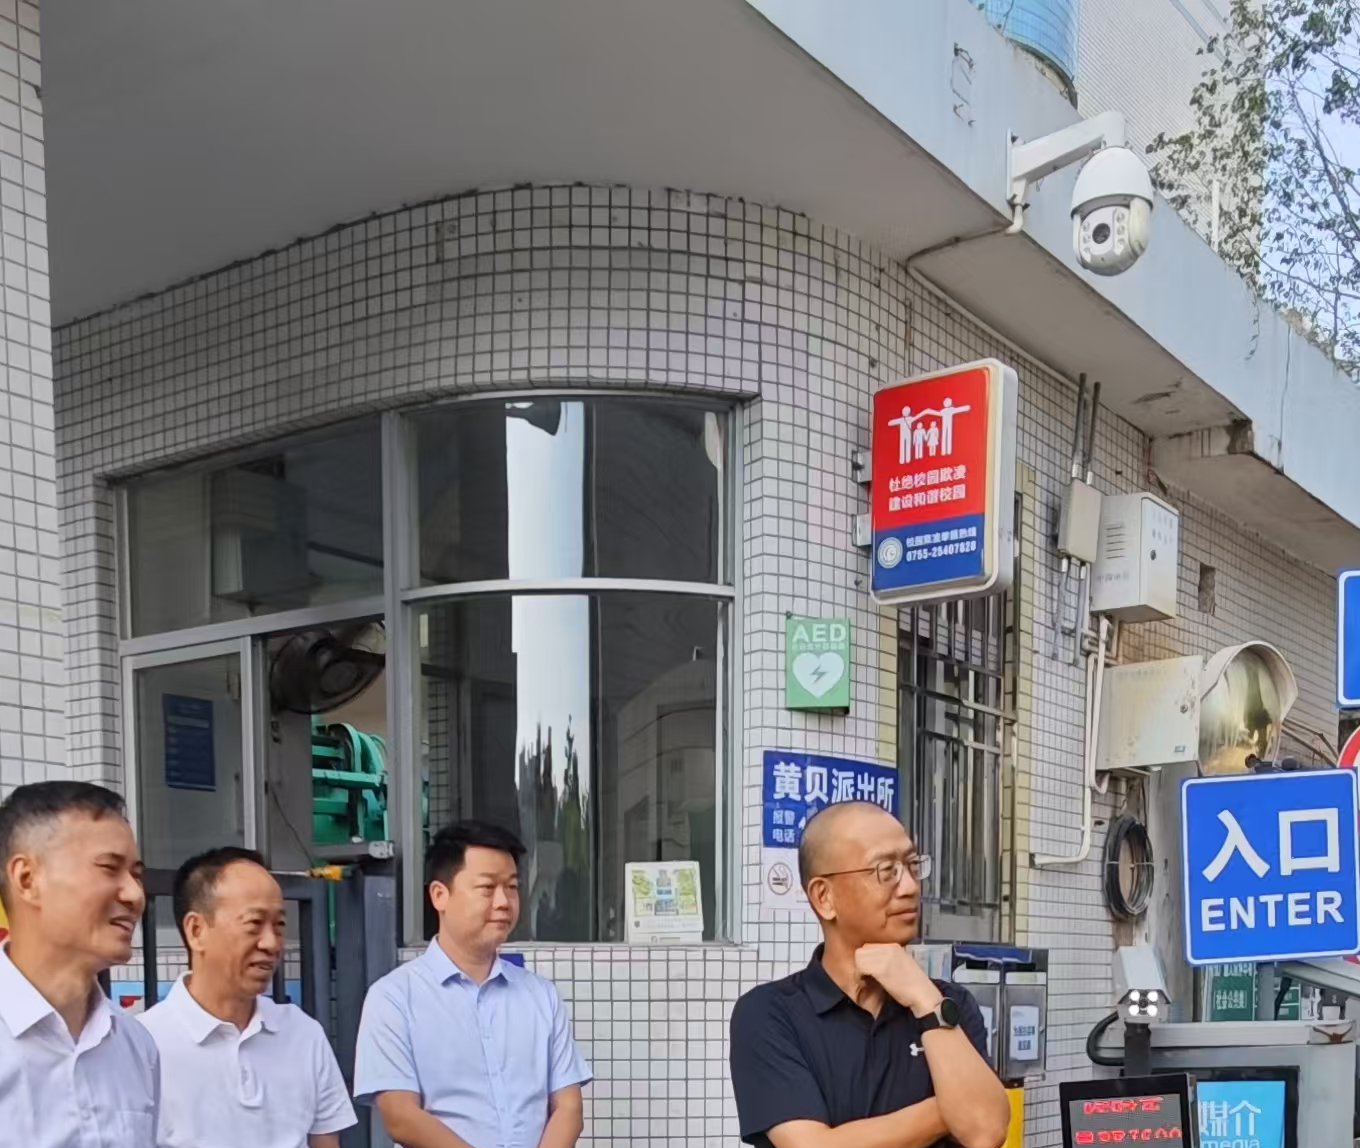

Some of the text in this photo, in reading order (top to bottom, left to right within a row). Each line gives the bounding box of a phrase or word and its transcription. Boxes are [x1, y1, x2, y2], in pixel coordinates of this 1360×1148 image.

[888, 484, 966, 512] 建设和谐校园
[792, 623, 846, 642] AED
[772, 761, 894, 813] 黄贝派出所
[772, 828, 795, 843] 电话
[1202, 807, 1340, 882] 入口
[1201, 890, 1345, 932] ENTER
